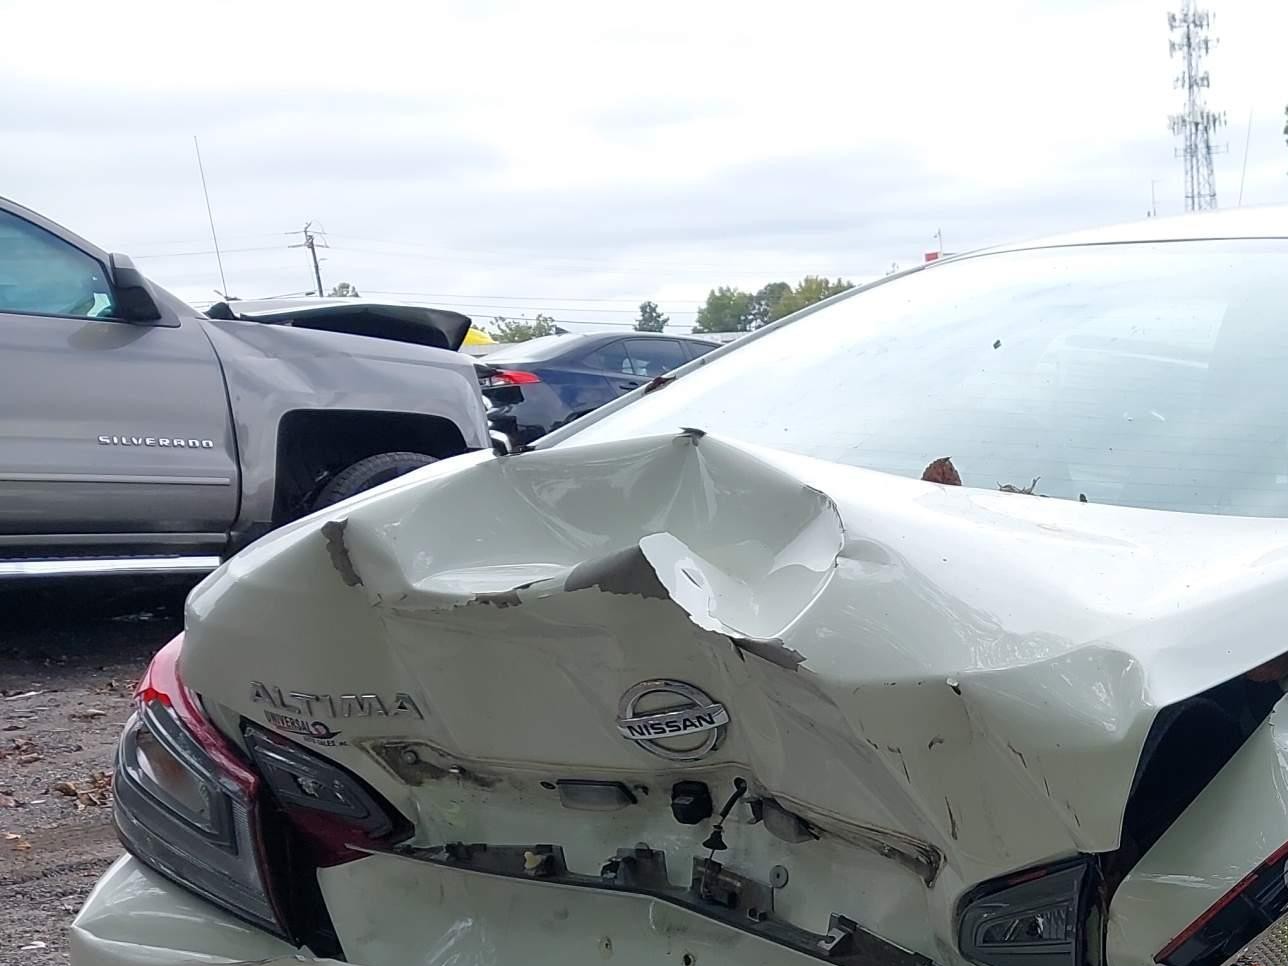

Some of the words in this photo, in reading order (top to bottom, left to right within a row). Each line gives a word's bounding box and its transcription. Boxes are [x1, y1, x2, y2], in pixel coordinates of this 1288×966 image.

[98, 435, 214, 449] SILVERADO
[249, 681, 424, 720] ALTIMA
[627, 712, 716, 737] NISSAN
